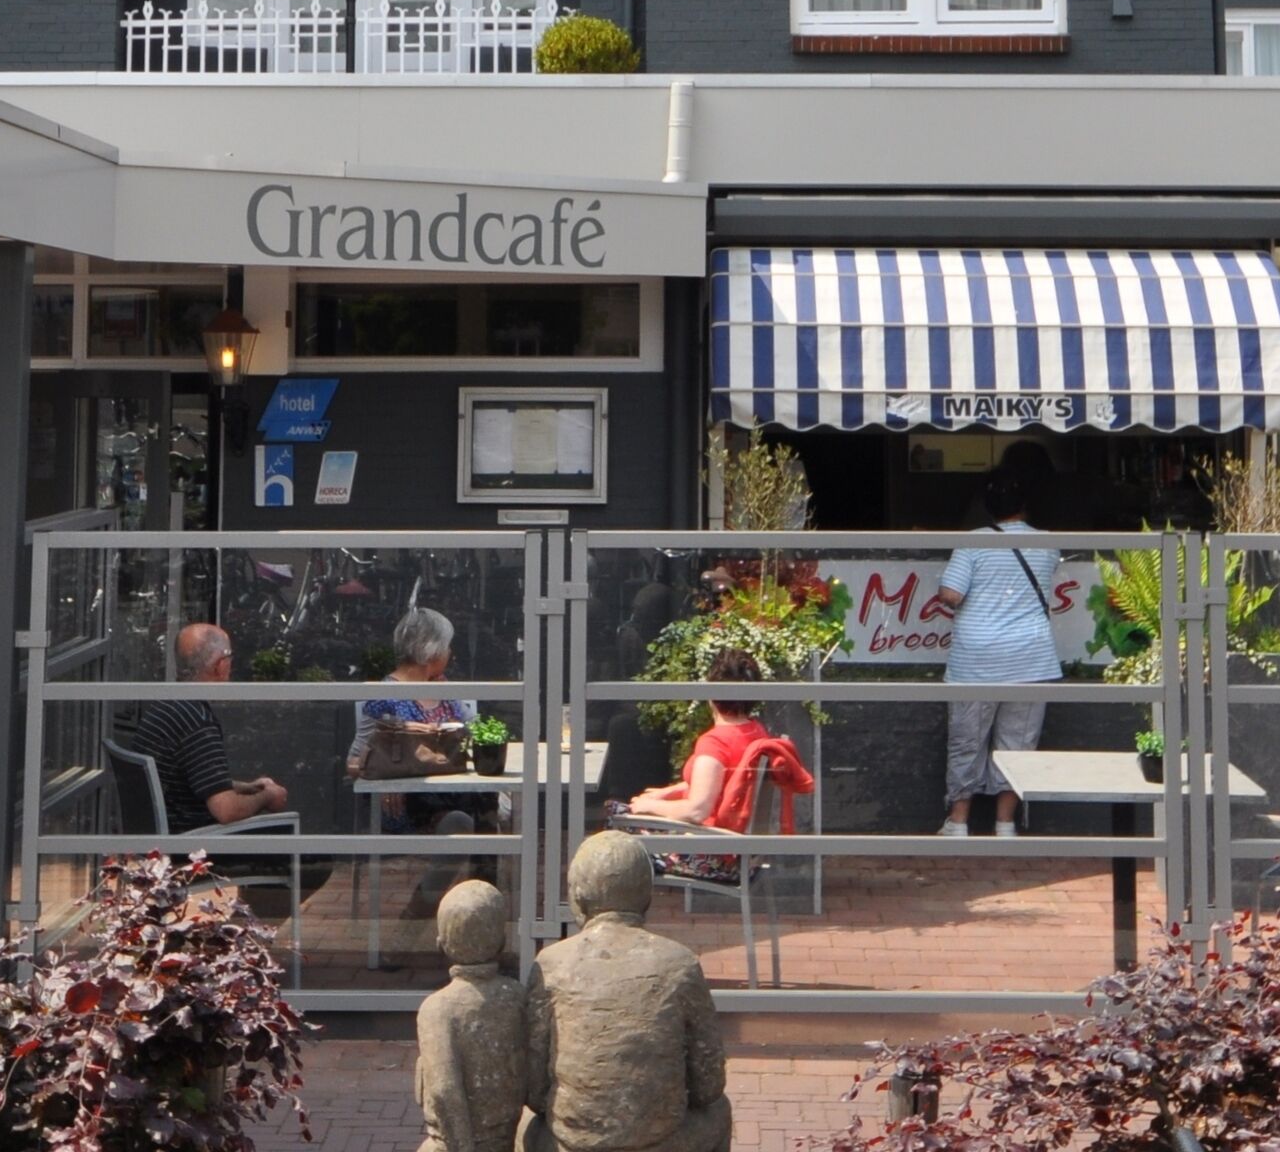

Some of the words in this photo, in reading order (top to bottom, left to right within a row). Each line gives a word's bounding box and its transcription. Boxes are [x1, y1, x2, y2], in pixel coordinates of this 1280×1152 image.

[245, 183, 608, 269] Grandcafé
[279, 394, 316, 412] hotel
[943, 396, 1074, 419] MAIKY'S
